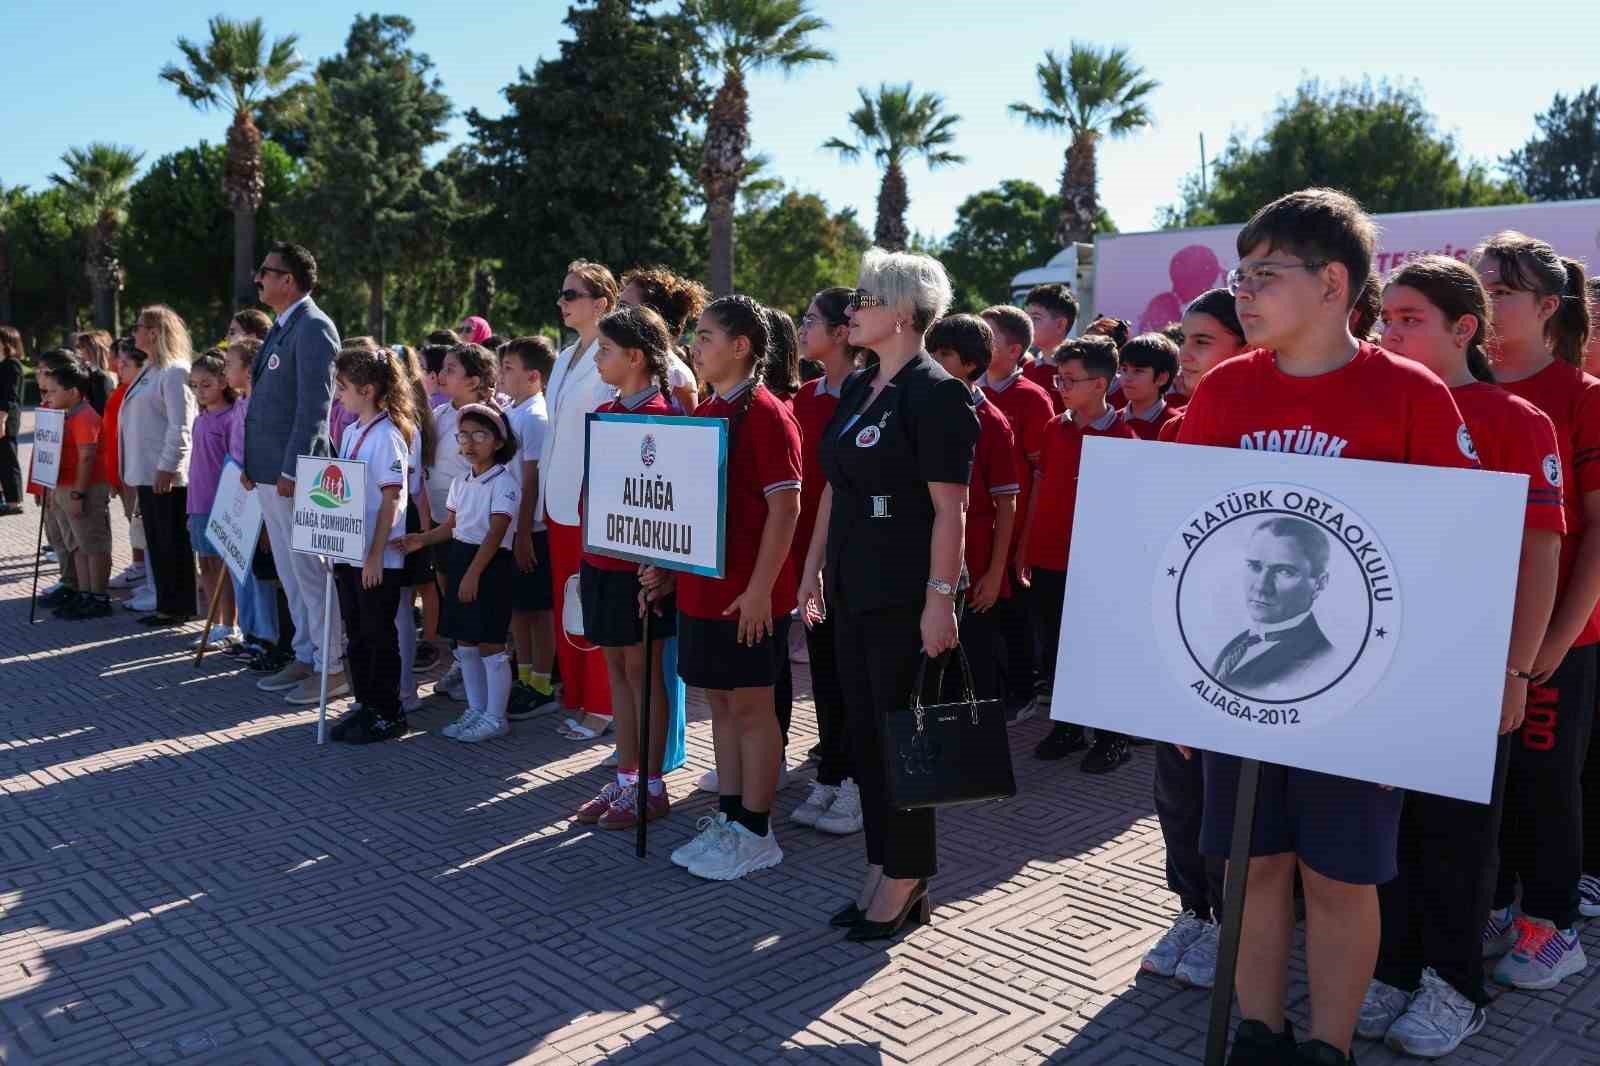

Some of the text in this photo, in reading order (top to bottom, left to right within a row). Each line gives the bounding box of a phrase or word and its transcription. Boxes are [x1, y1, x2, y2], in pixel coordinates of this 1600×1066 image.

[1240, 424, 1348, 457] ATATÜRK
[623, 472, 674, 512] ALİAĞA
[311, 528, 345, 553] İLKOKULU
[606, 513, 692, 555] ORTAOKULU
[1182, 489, 1394, 602] ATATÜRK ORTAOKULU
[1190, 679, 1301, 725] ALİAĞA-2012
